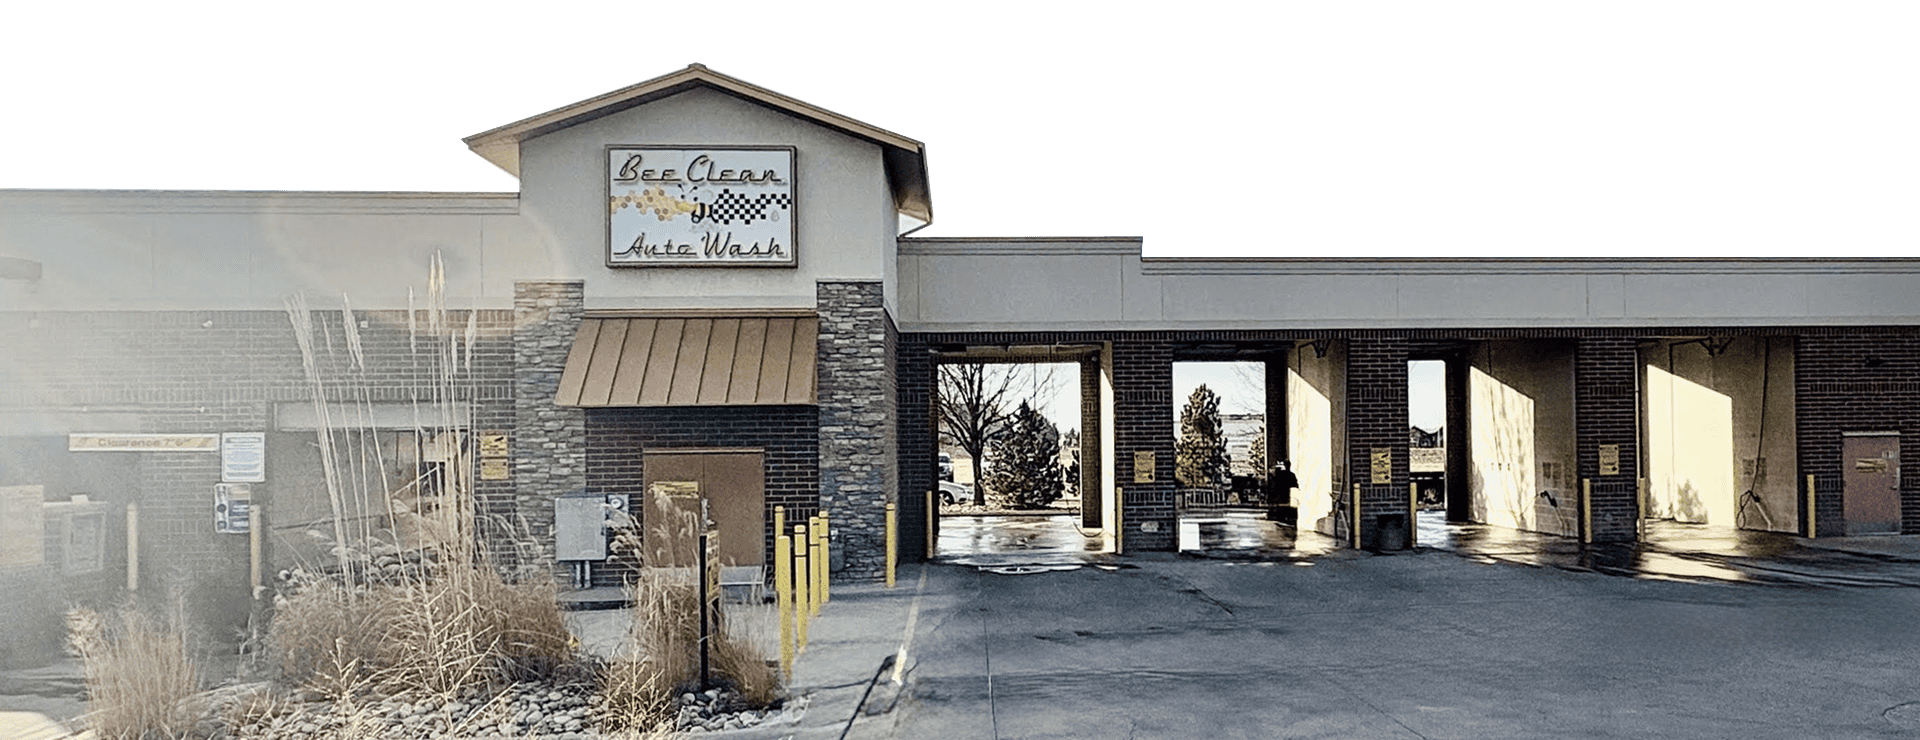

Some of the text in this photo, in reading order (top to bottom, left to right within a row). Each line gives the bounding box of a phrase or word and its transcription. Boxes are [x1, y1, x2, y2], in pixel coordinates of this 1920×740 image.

[613, 154, 782, 183] Bee Clean
[613, 231, 784, 256] Auto Wash
[98, 438, 160, 448] Clearance
